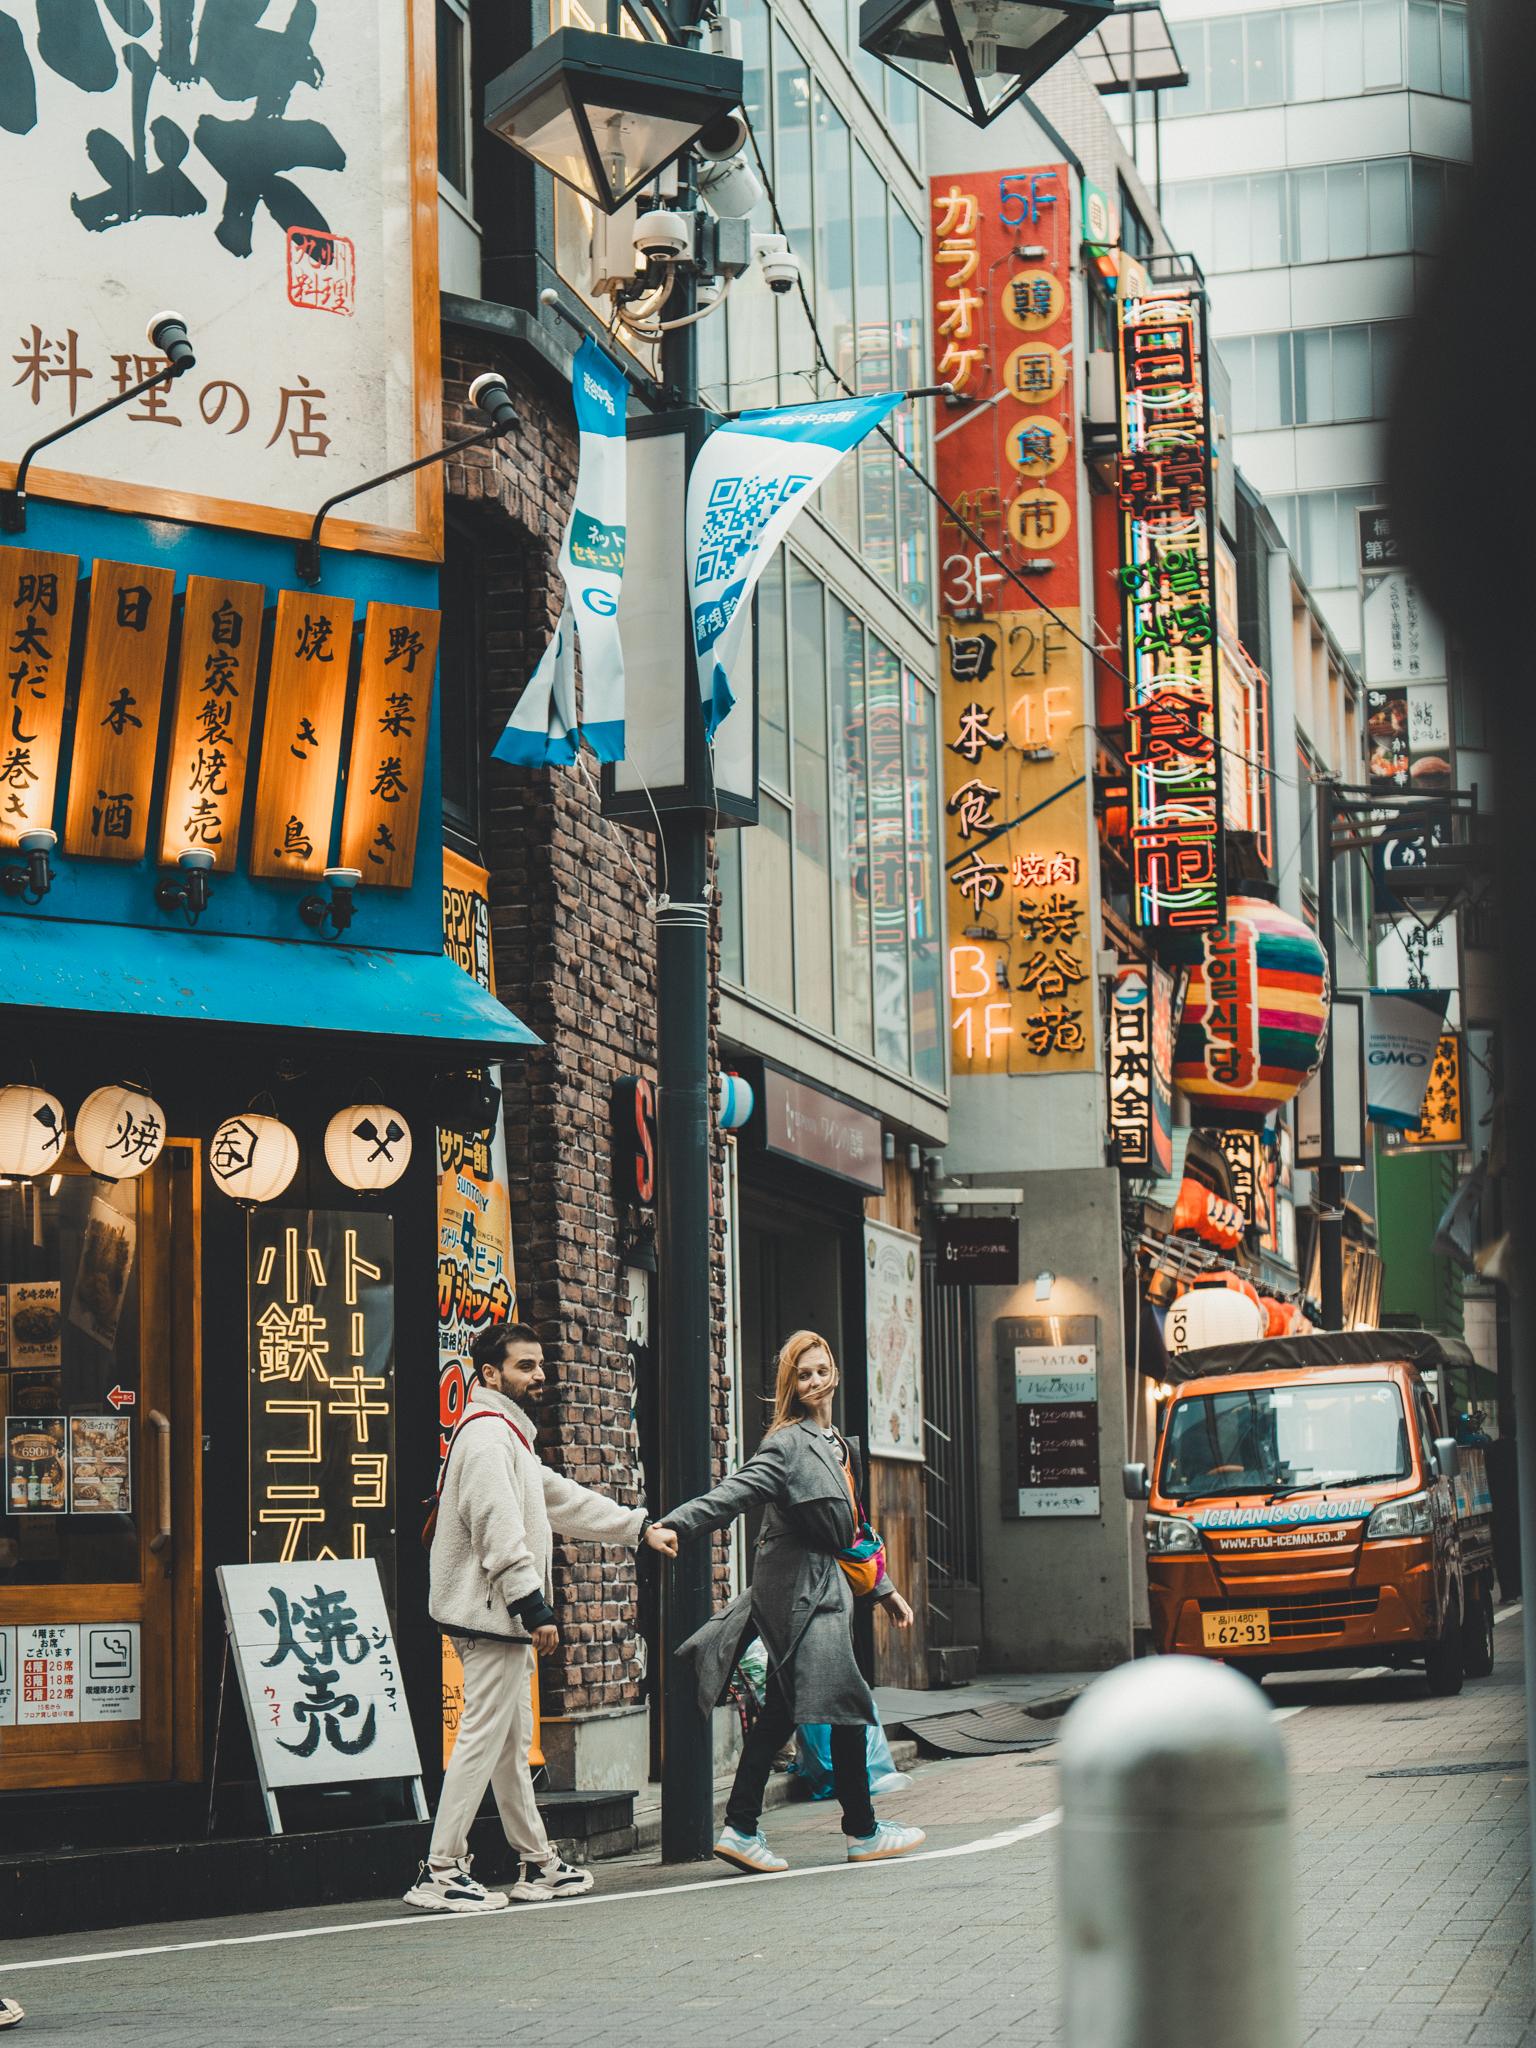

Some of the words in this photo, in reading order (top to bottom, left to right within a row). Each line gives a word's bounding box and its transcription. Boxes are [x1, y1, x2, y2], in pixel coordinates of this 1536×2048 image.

[1000, 173, 1057, 225] 5F
[294, 239, 349, 272] 九州
[291, 276, 351, 313] 料理
[934, 185, 984, 392] カラオケ
[12, 324, 334, 459] 料理の店
[1011, 276, 1056, 538] 韓国食市
[943, 552, 1002, 606] 3F
[1009, 622, 1067, 676] 2F
[0, 572, 58, 831] 明太だし巻き
[90, 585, 153, 840] 日本酒
[184, 600, 243, 845] 自家製焼売
[1011, 687, 1072, 741] 1F
[273, 614, 335, 860] 焼き鳥
[367, 626, 425, 865] 野菜巻き
[945, 633, 1008, 919] 日本食市
[1013, 852, 1079, 887] 焼肉
[949, 945, 990, 998] B
[1019, 894, 1088, 1055] 渋谷苑
[952, 1002, 1012, 1059] 1F
[1111, 1007, 1149, 1159] 日本全国
[1369, 1050, 1427, 1067] GMO
[106, 1110, 161, 1166] 焼
[1041, 1356, 1076, 1366] YATA
[329, 1229, 389, 1562] トーキョー
[1202, 1508, 1266, 1527] ICEMAN
[1267, 1506, 1284, 1523] IS
[1288, 1503, 1310, 1520] SO
[1316, 1498, 1366, 1519] COOL!
[1220, 1531, 1347, 1549] WWW.FUJI-ICEMAN.CO.JP
[26, 1648, 72, 1657] ございます
[32, 1629, 65, 1639] 4階まで
[40, 1639, 58, 1648] お席
[1219, 1624, 1267, 1643] 62-93
[49, 1661, 74, 1671] 26席
[50, 1675, 74, 1685] 18席
[86, 1685, 136, 1694] 喫煙席あります
[259, 1584, 376, 1757] 焼売
[371, 1627, 397, 1712] シュウマイ
[49, 1689, 74, 1699] 22席
[264, 1686, 281, 1726] ウマイ
